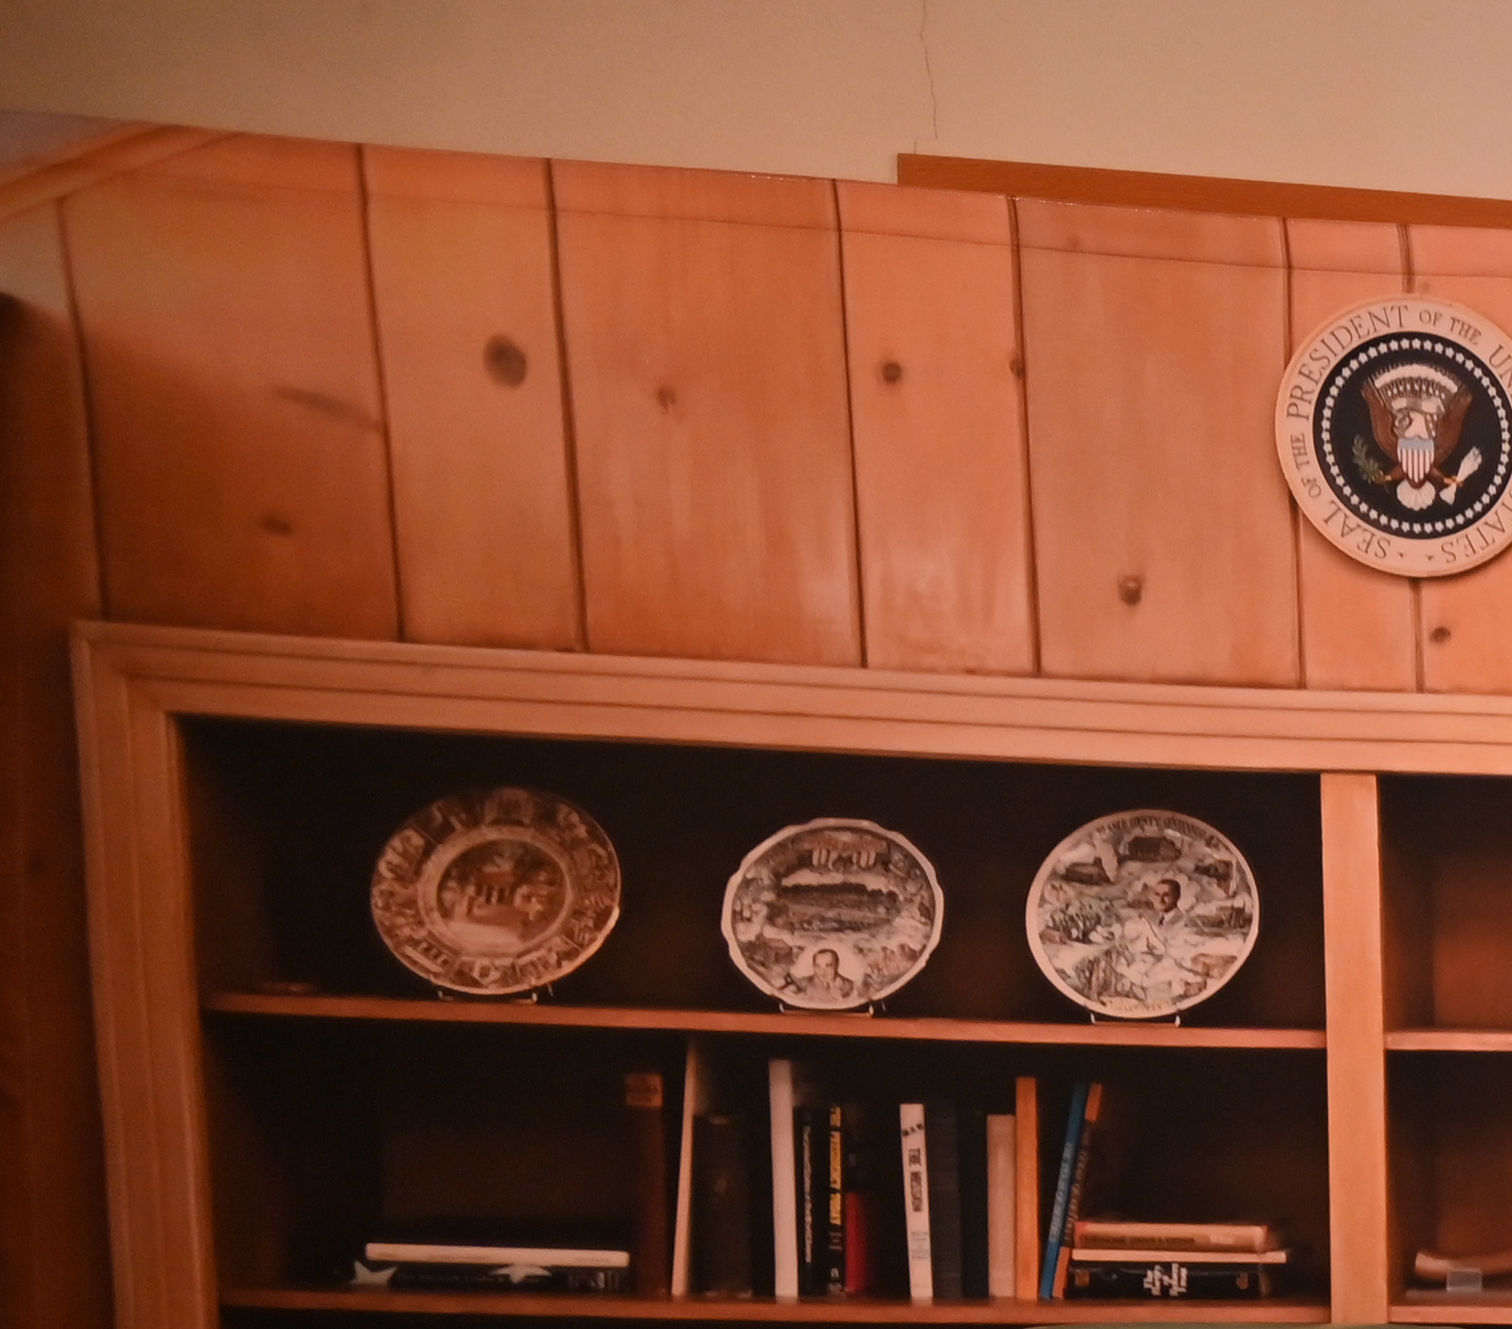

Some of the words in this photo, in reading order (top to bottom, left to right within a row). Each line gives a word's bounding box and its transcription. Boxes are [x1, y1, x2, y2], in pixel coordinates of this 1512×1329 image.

[1418, 309, 1443, 327] OF
[1449, 316, 1482, 346] THE
[1286, 305, 1409, 421] PRESIDENT
[1290, 432, 1311, 471] THE
[1301, 475, 1322, 499] OF
[1321, 500, 1391, 560] SEAL
